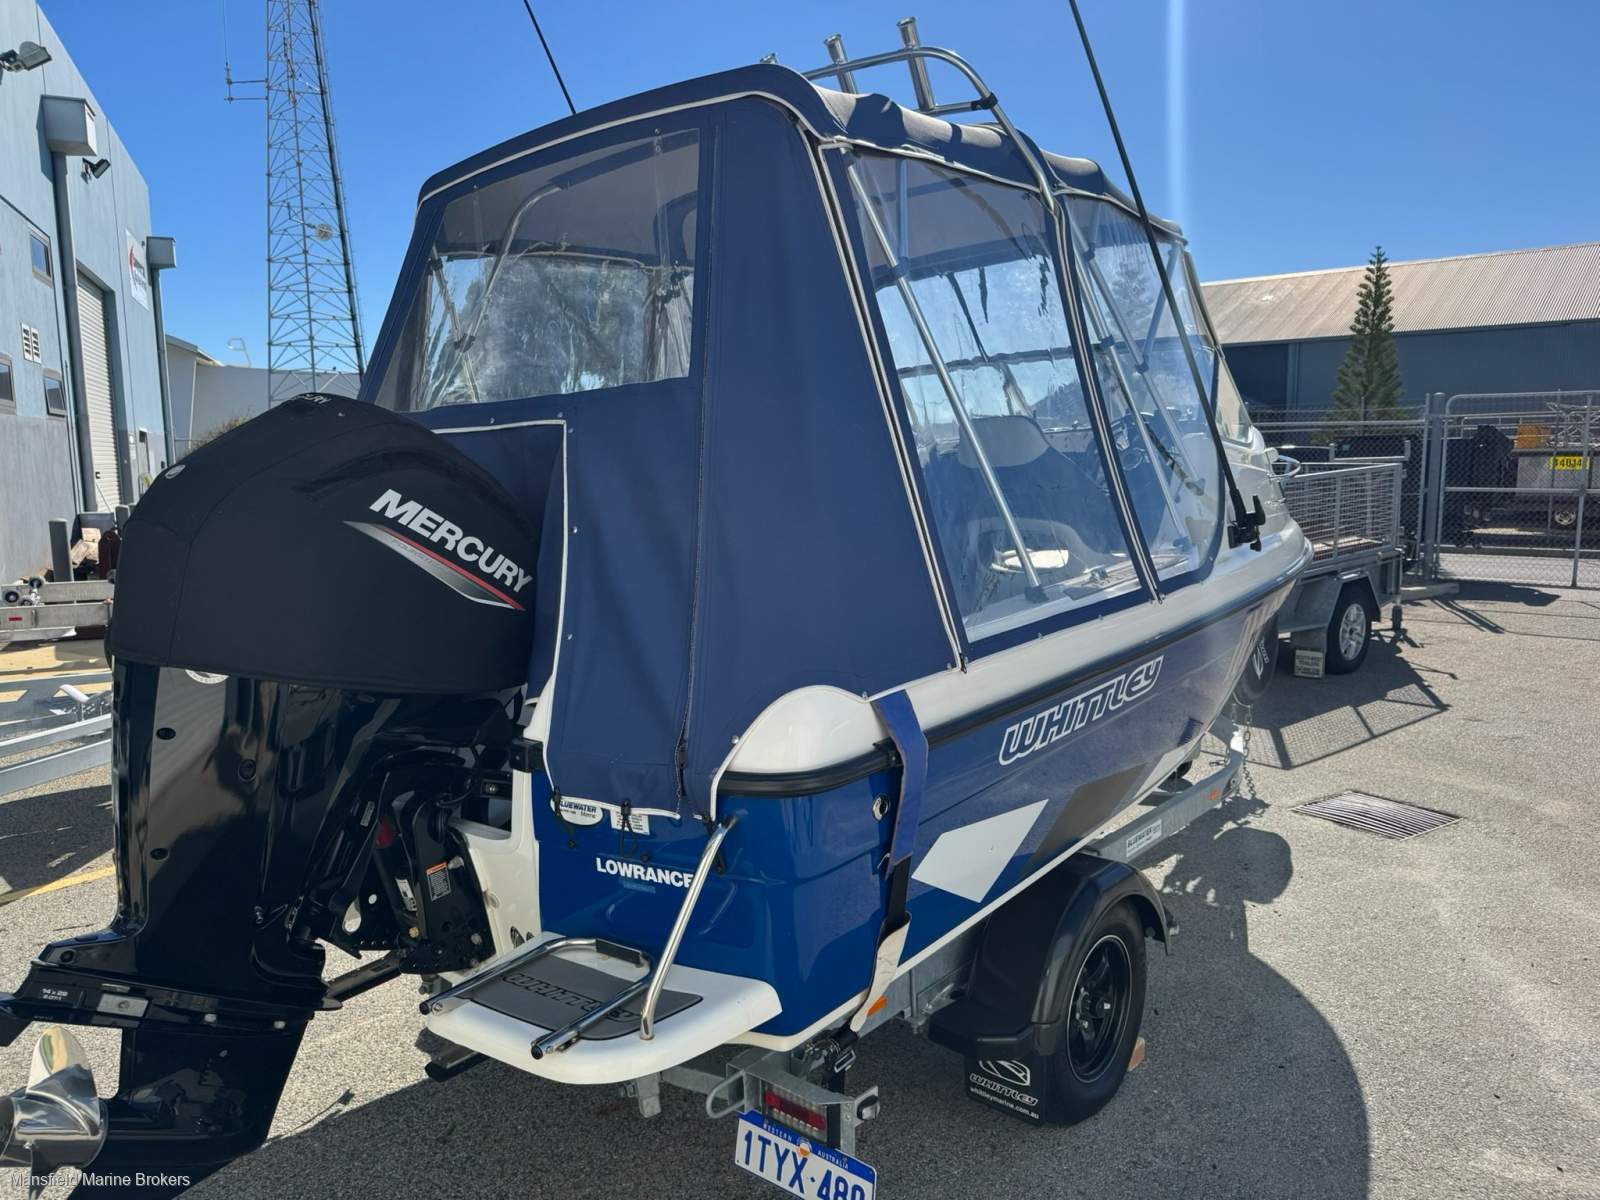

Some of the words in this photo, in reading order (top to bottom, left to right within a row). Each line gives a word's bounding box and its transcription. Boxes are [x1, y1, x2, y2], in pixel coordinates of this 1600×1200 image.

[369, 488, 533, 593] MERCURY
[998, 655, 1164, 766] WHITTLEY
[559, 800, 597, 814] LUEWATER
[595, 857, 695, 889] LOWRANCE
[762, 1123, 793, 1143] WESTERN
[817, 1150, 849, 1170] AUSTRALIA
